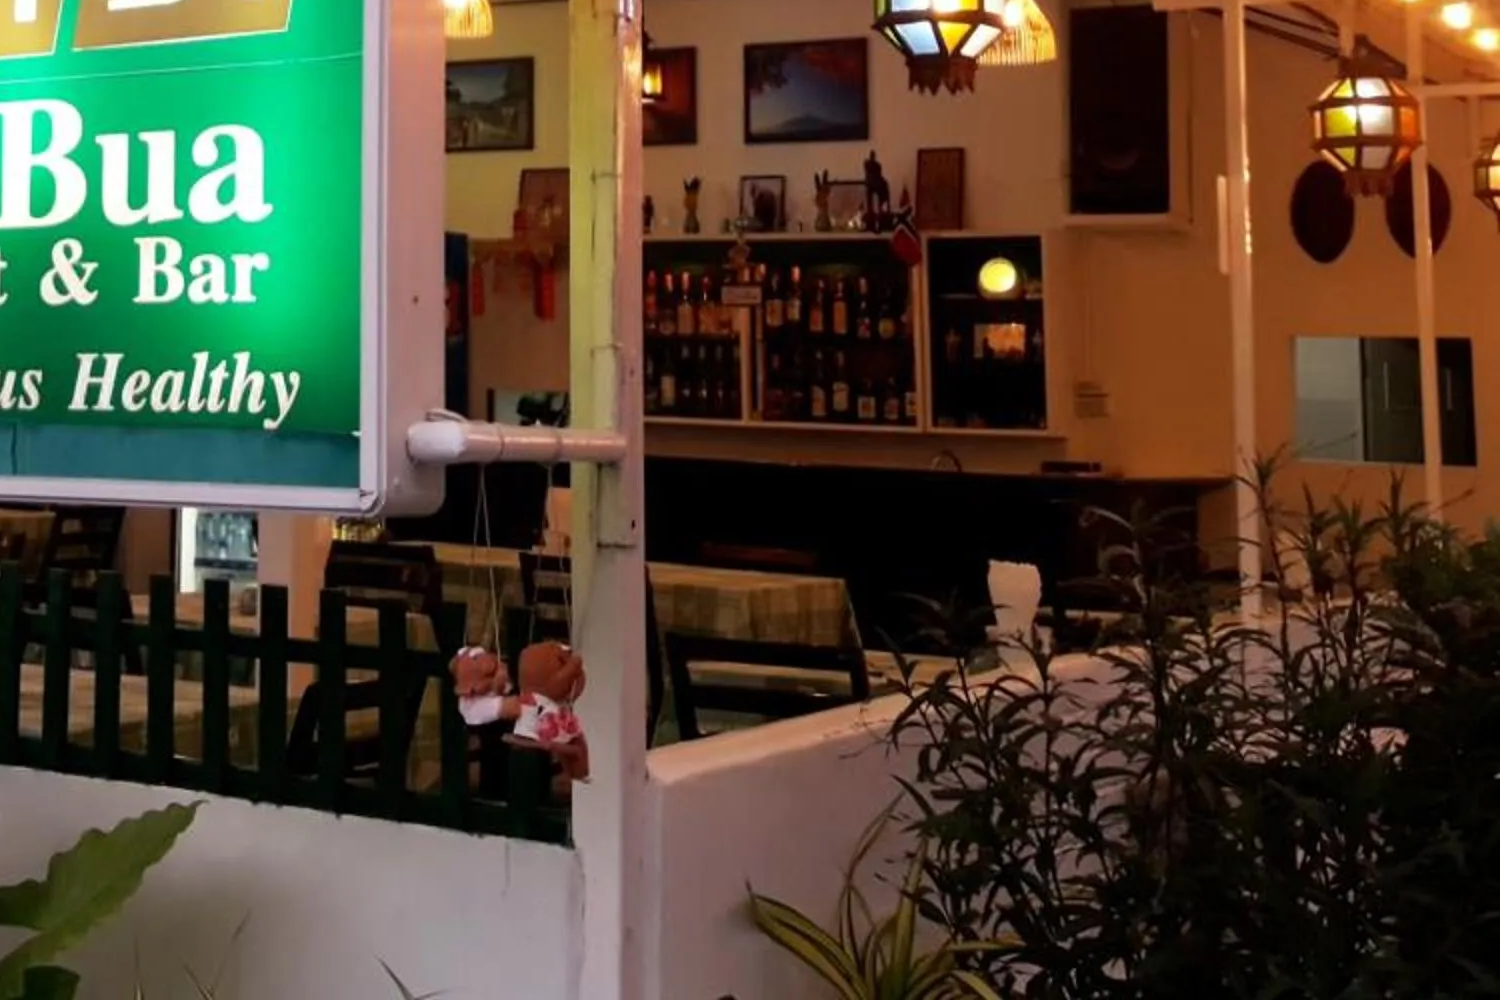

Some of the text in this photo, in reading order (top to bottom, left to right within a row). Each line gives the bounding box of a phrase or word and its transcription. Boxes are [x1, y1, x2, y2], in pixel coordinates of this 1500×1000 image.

[40, 238, 99, 305] &
[133, 236, 270, 304] Bar
[67, 351, 301, 431] Healthy
